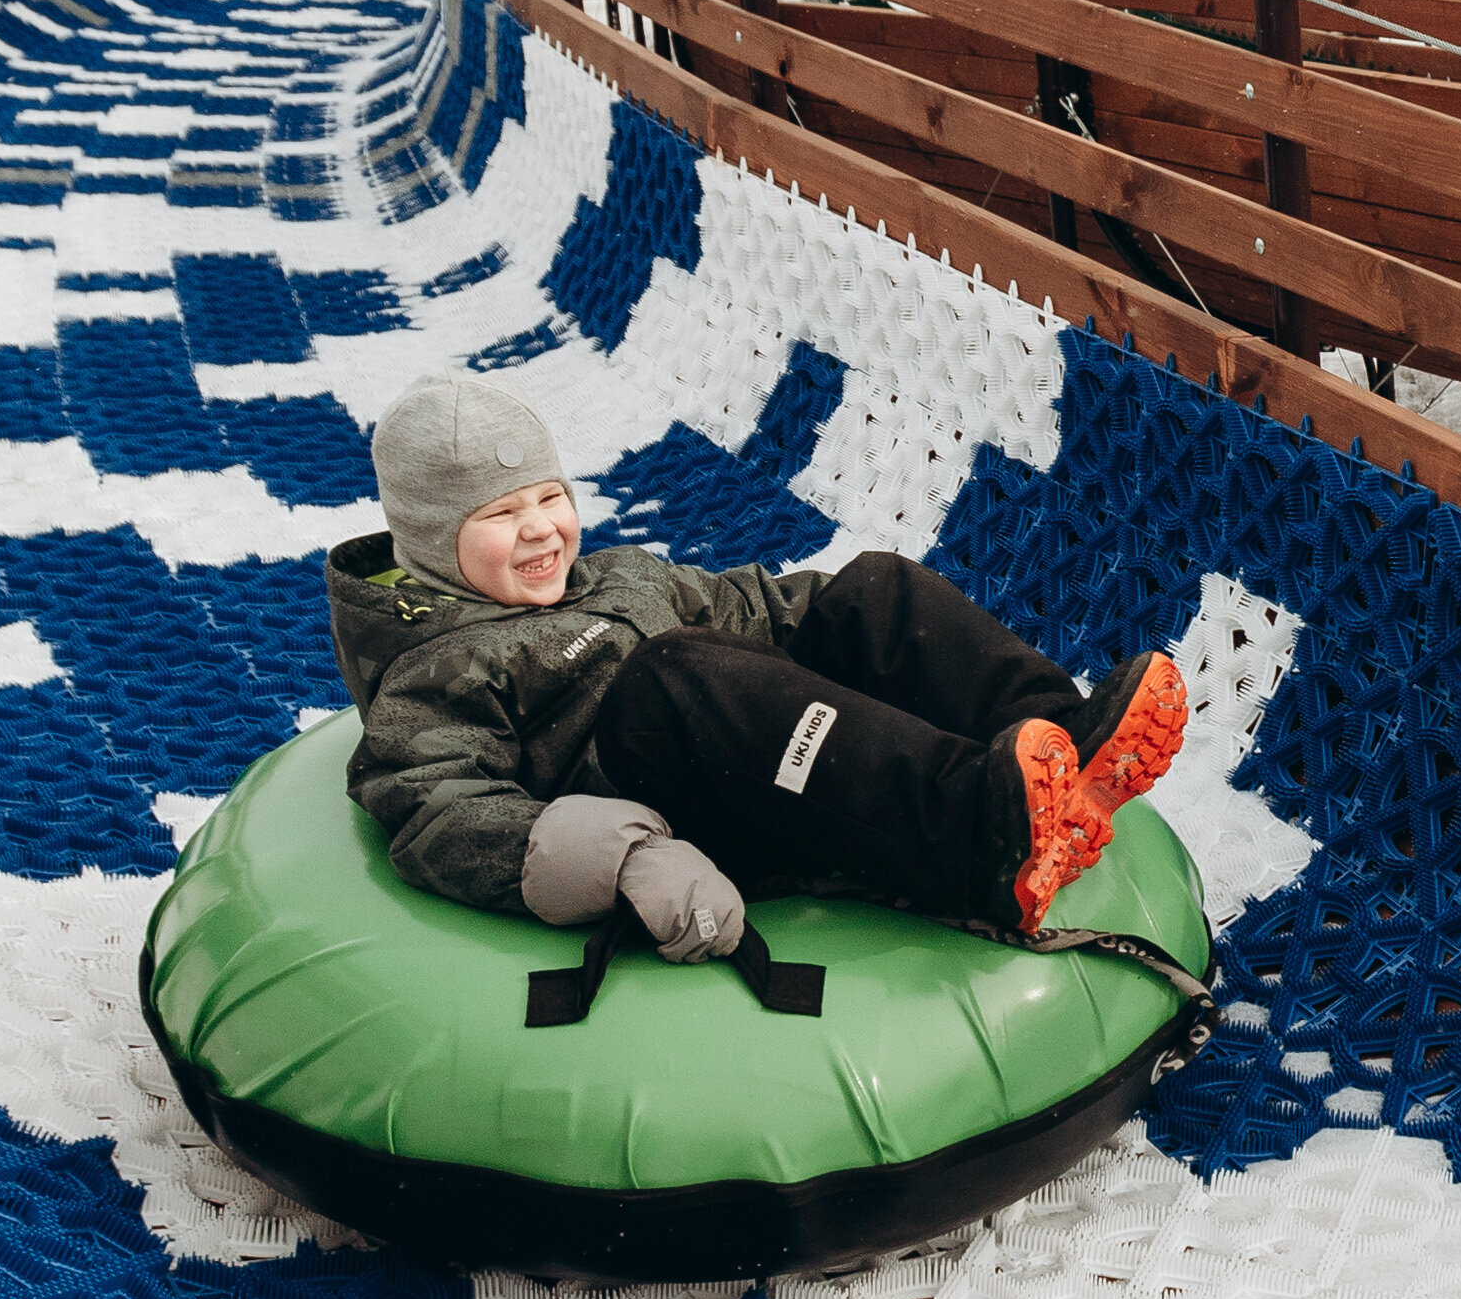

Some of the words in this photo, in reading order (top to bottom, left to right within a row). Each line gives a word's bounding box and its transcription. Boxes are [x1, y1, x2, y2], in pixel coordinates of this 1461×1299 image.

[562, 637, 587, 660] UKI
[582, 621, 611, 641] KIDS
[791, 741, 810, 767] UKI
[803, 709, 827, 741] KIDS
